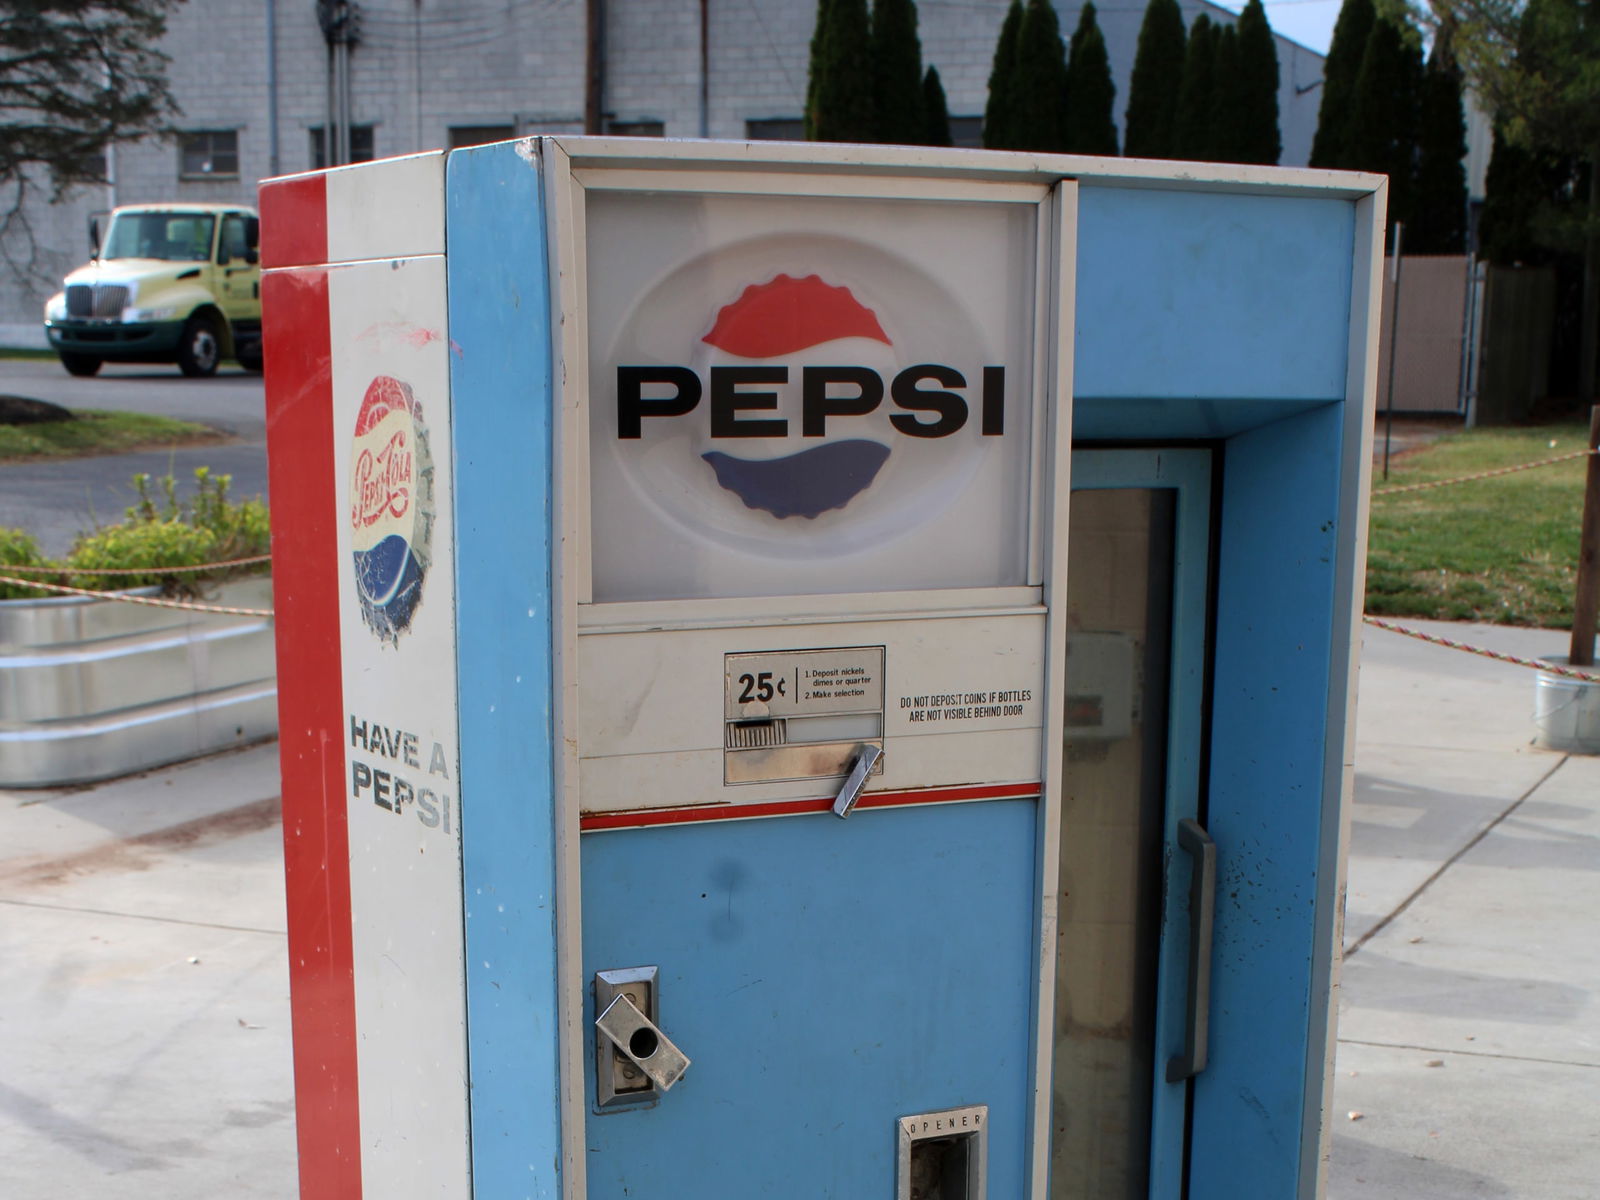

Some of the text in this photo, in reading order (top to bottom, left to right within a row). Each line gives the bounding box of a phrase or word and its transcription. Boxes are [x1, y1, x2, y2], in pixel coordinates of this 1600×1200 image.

[617, 364, 1006, 439] PEPSI
[812, 668, 839, 680] Deposit
[841, 667, 865, 676] nickels
[813, 679, 834, 687] dimes
[845, 677, 872, 687] quarter
[738, 672, 786, 704] 25¢
[812, 691, 831, 699] Make
[834, 689, 865, 699] selection
[900, 690, 1032, 709] DO NOT DEPOSIT COINS IF BOTTLES
[909, 704, 1023, 723] ARE NOT VISIBLE BEHIND DOOR
[350, 713, 450, 780] HAVE A
[352, 759, 451, 835] PEPSI
[910, 1115, 980, 1133] OPENER
